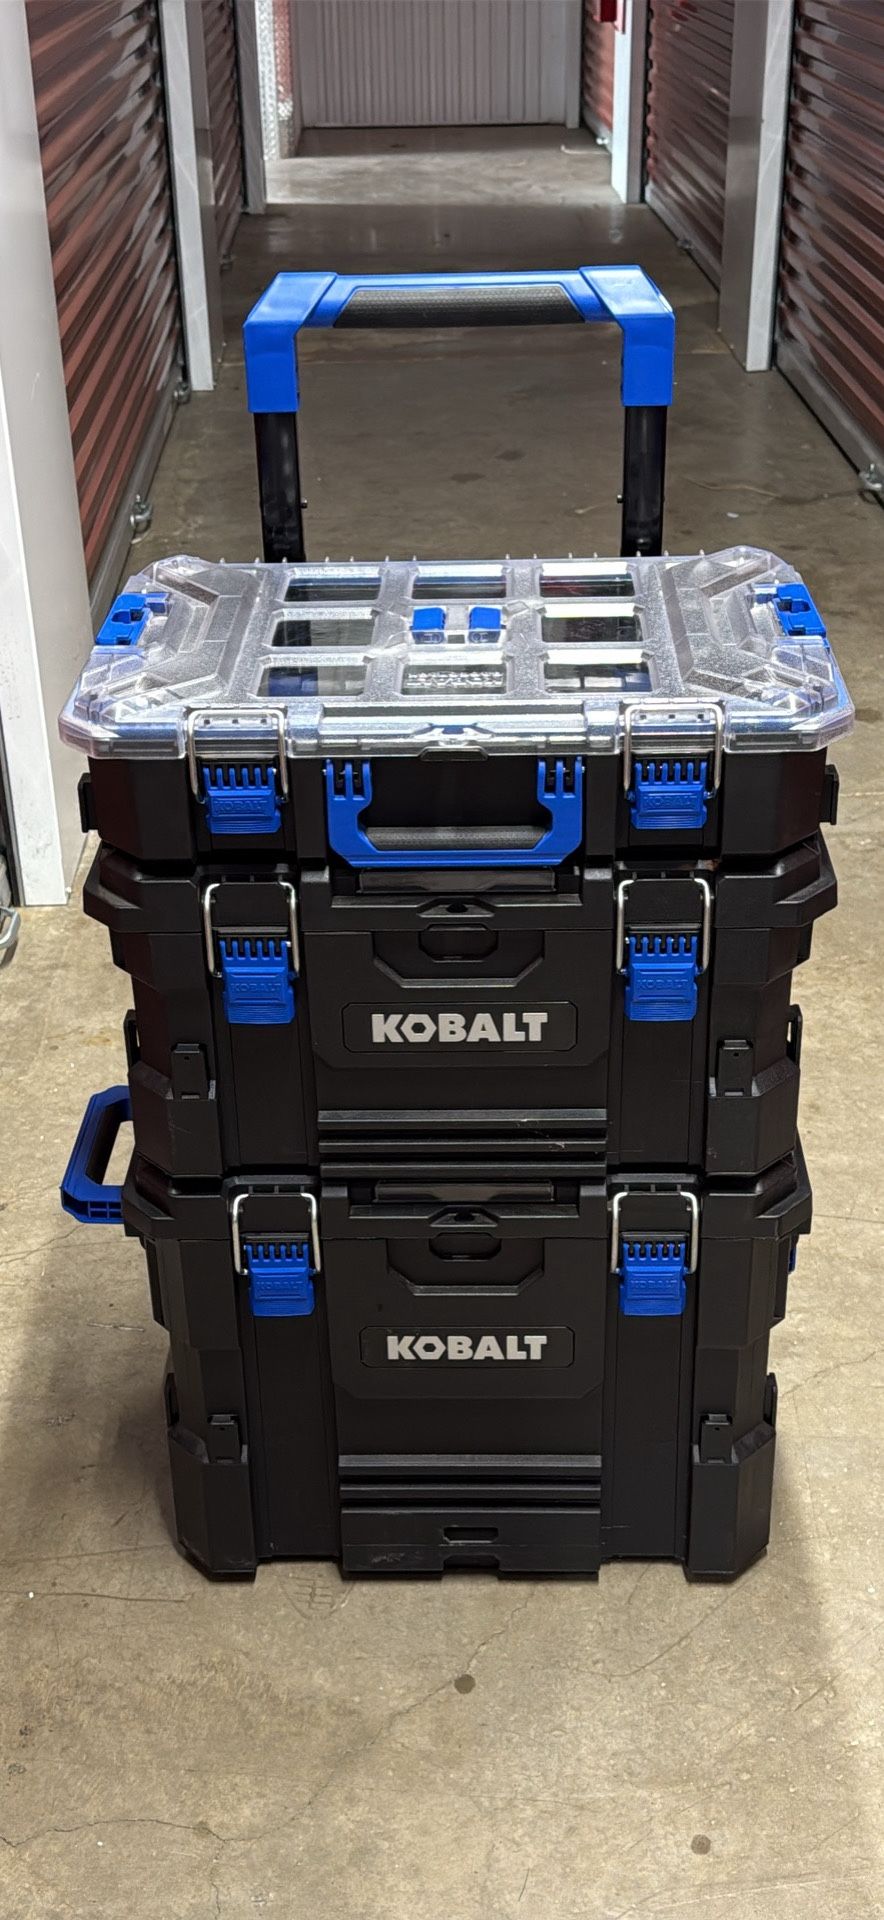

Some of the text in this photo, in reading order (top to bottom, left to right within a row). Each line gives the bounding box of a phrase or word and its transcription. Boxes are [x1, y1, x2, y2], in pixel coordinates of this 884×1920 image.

[230, 983, 281, 992] KOBALT
[371, 1012, 548, 1043] KOBALT
[387, 1335, 547, 1360] KOBALT
